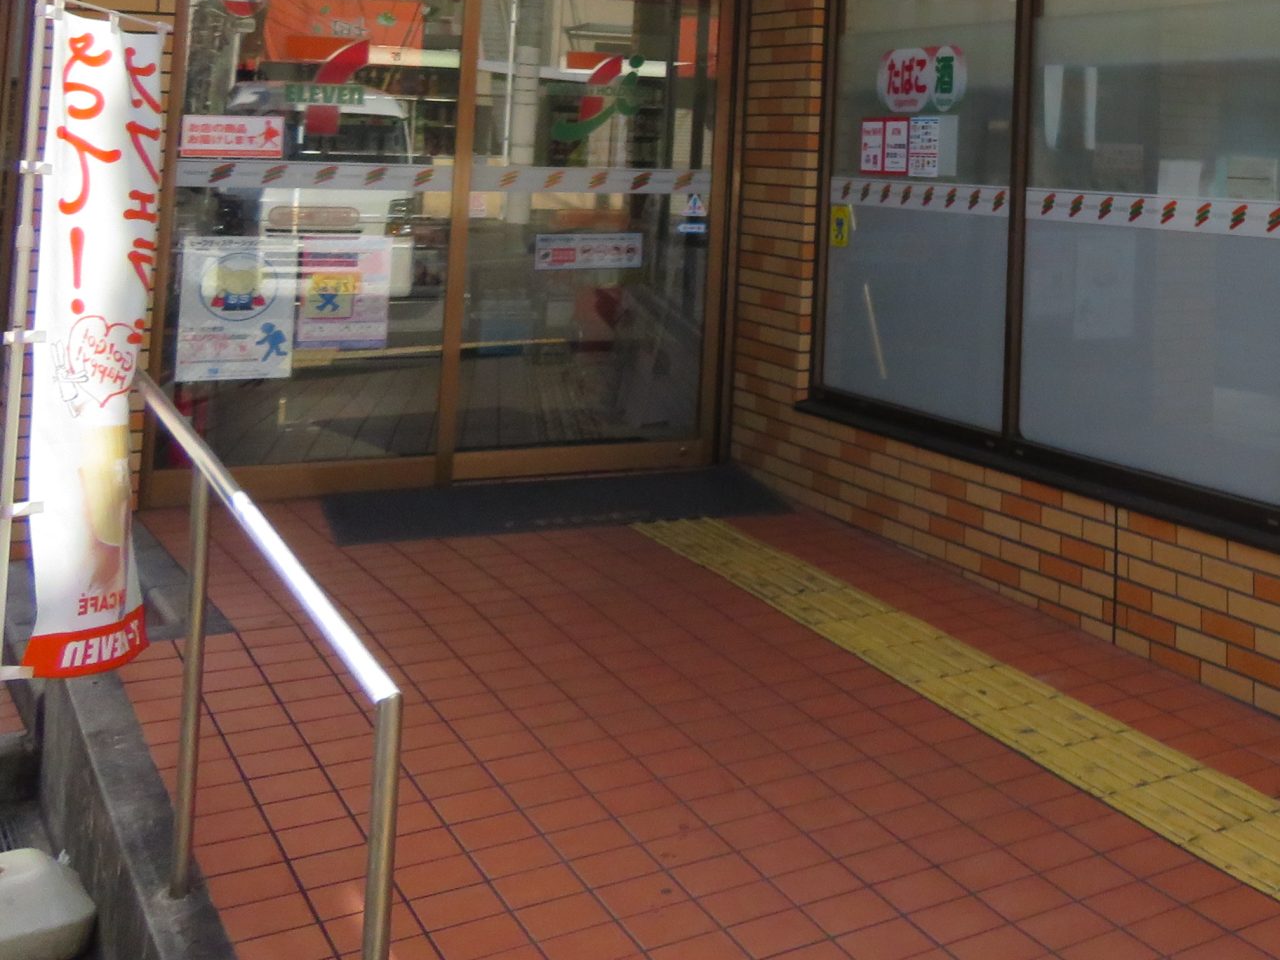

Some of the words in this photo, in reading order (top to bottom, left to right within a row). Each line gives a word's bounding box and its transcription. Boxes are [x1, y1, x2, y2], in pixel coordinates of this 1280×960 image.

[887, 56, 927, 95] たばこ
[935, 55, 955, 95] 酒
